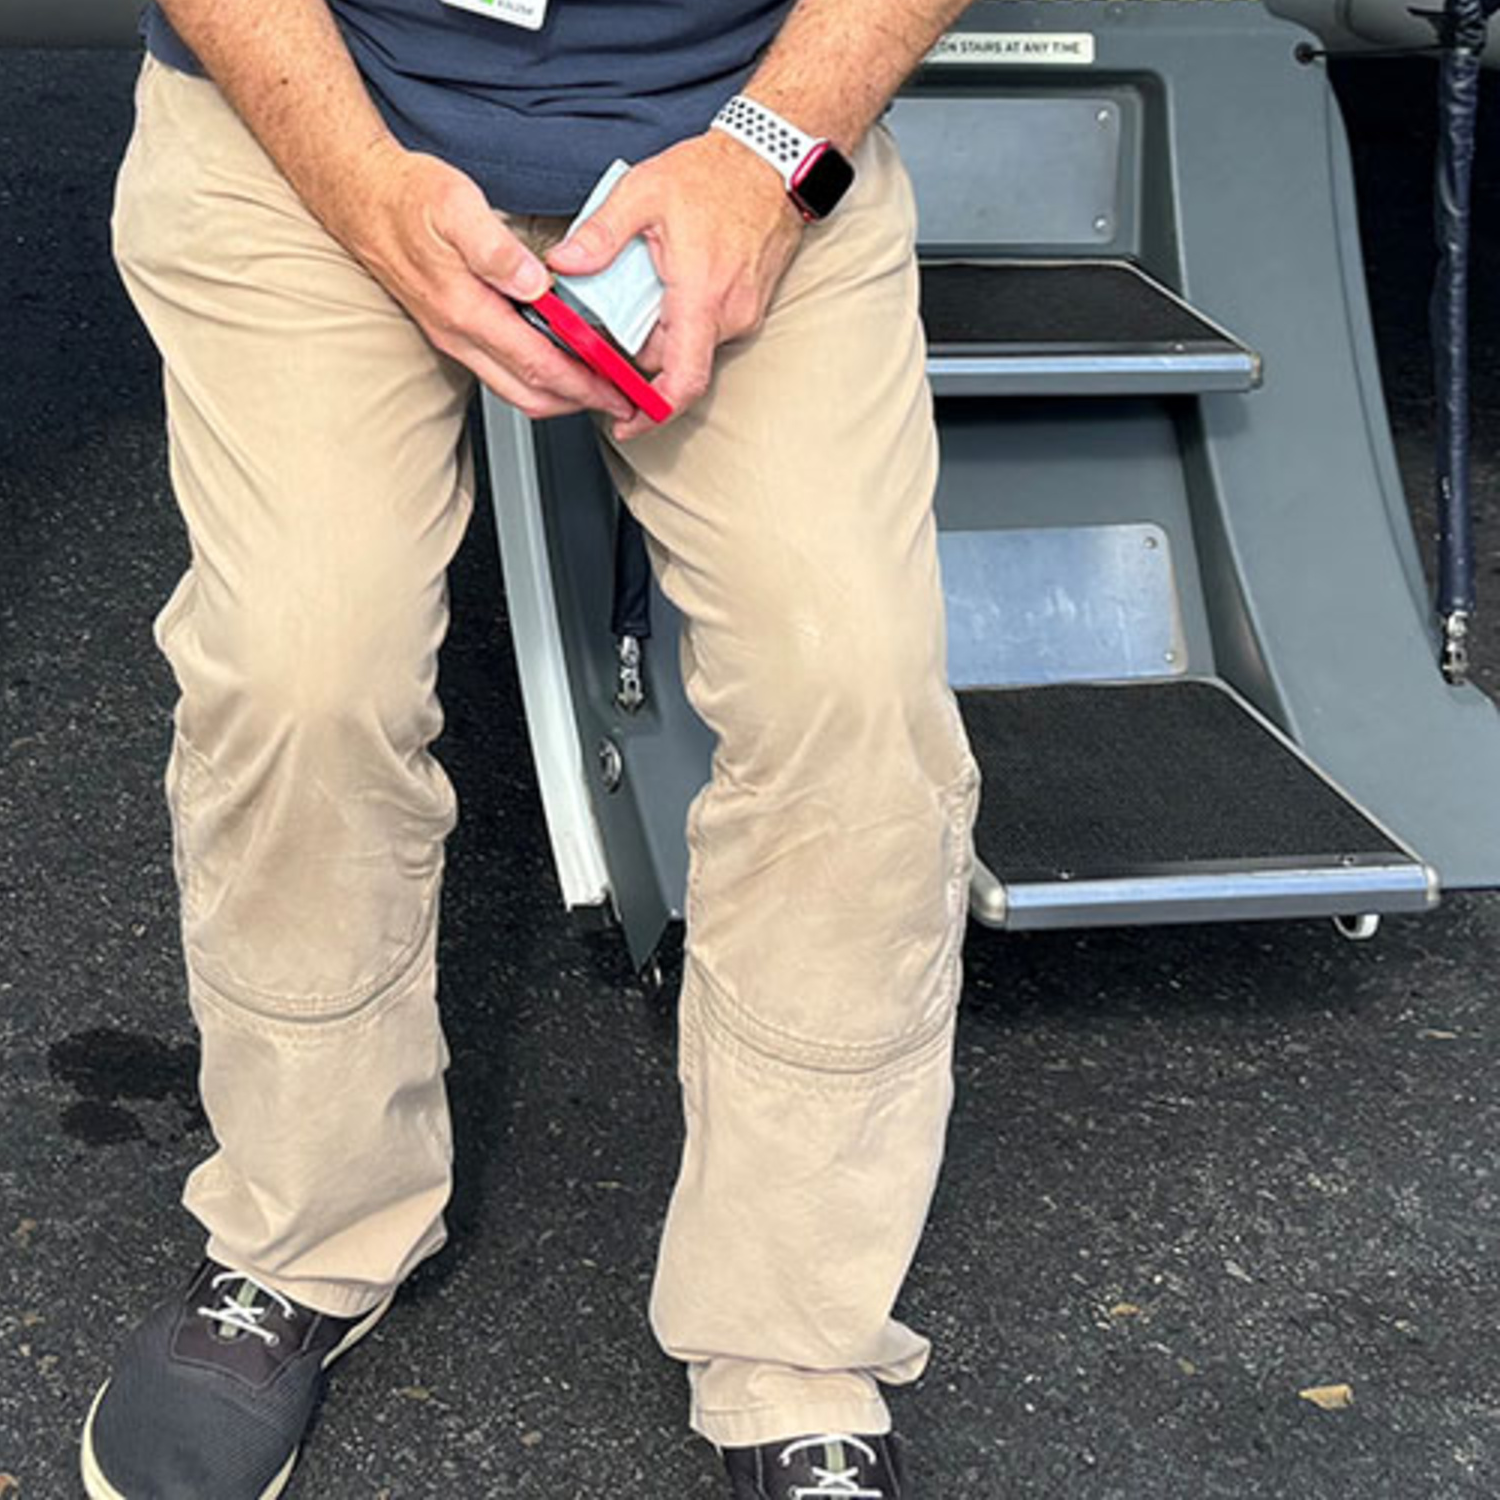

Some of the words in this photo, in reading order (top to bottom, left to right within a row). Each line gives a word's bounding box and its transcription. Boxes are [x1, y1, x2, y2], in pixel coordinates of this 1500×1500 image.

[960, 41, 1001, 54] STAIRS
[1005, 41, 1020, 54] AT
[1023, 41, 1049, 54] ANY
